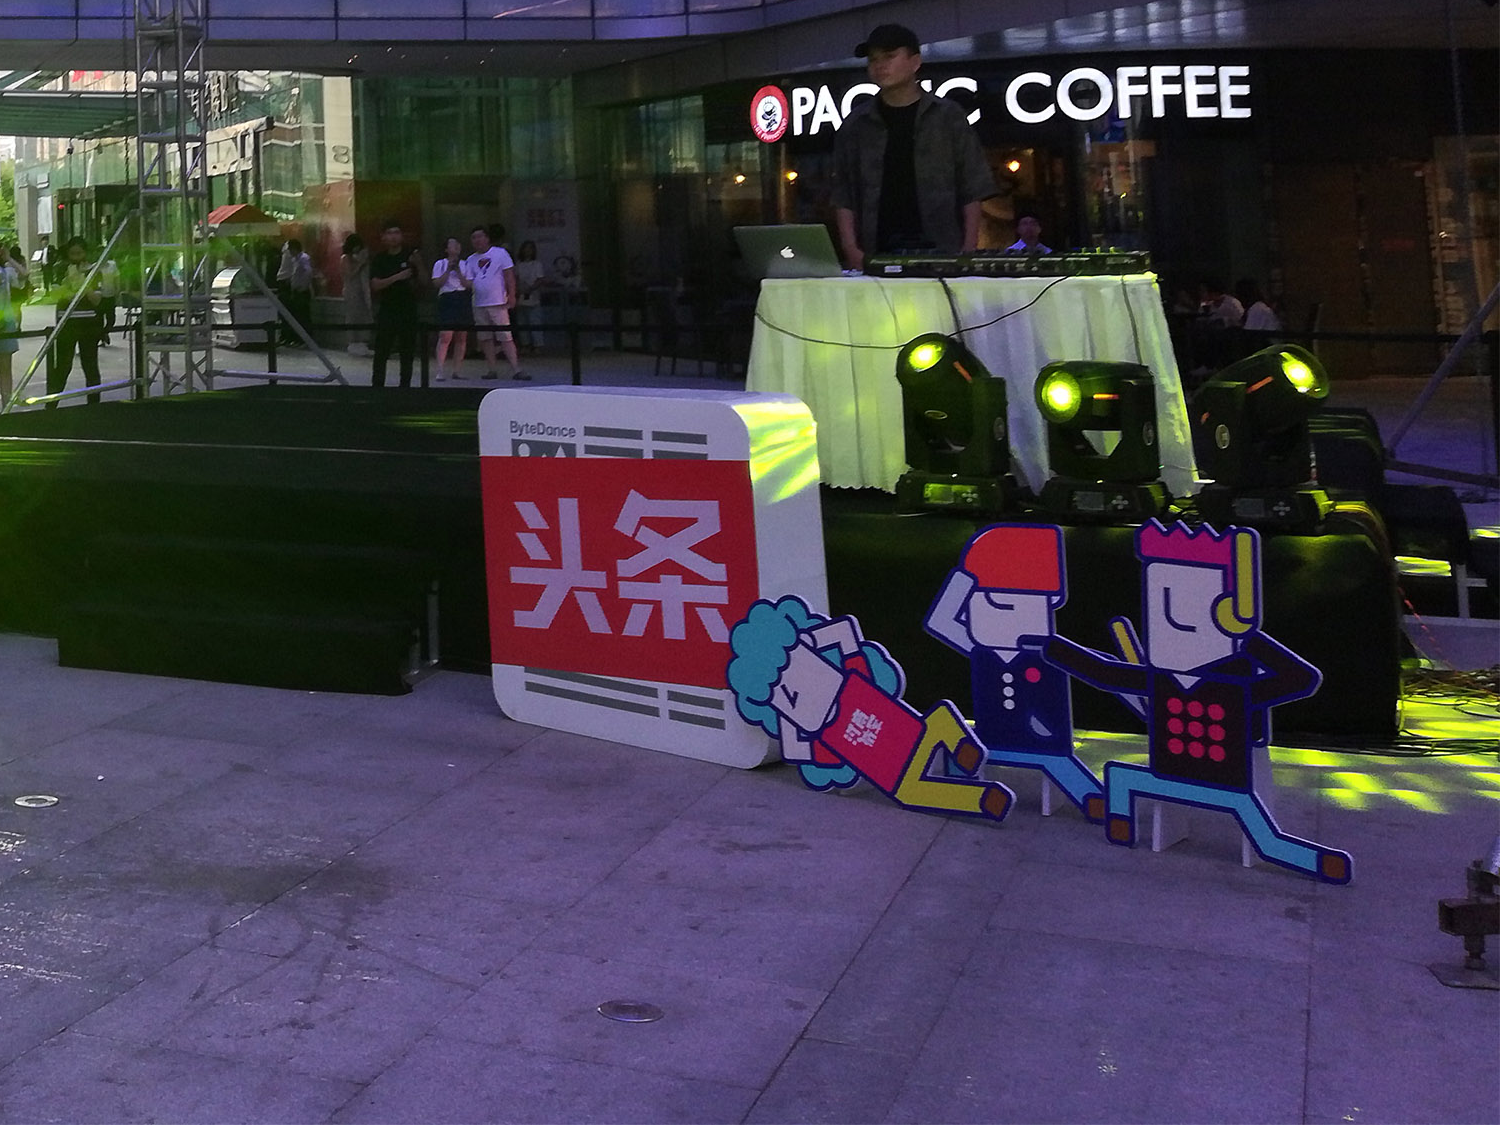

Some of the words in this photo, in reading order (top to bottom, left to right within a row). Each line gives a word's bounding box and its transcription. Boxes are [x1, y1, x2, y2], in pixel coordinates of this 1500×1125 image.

[1005, 65, 1252, 124] COFFEE
[509, 420, 577, 438] ByteDance
[510, 489, 729, 643] 头条
